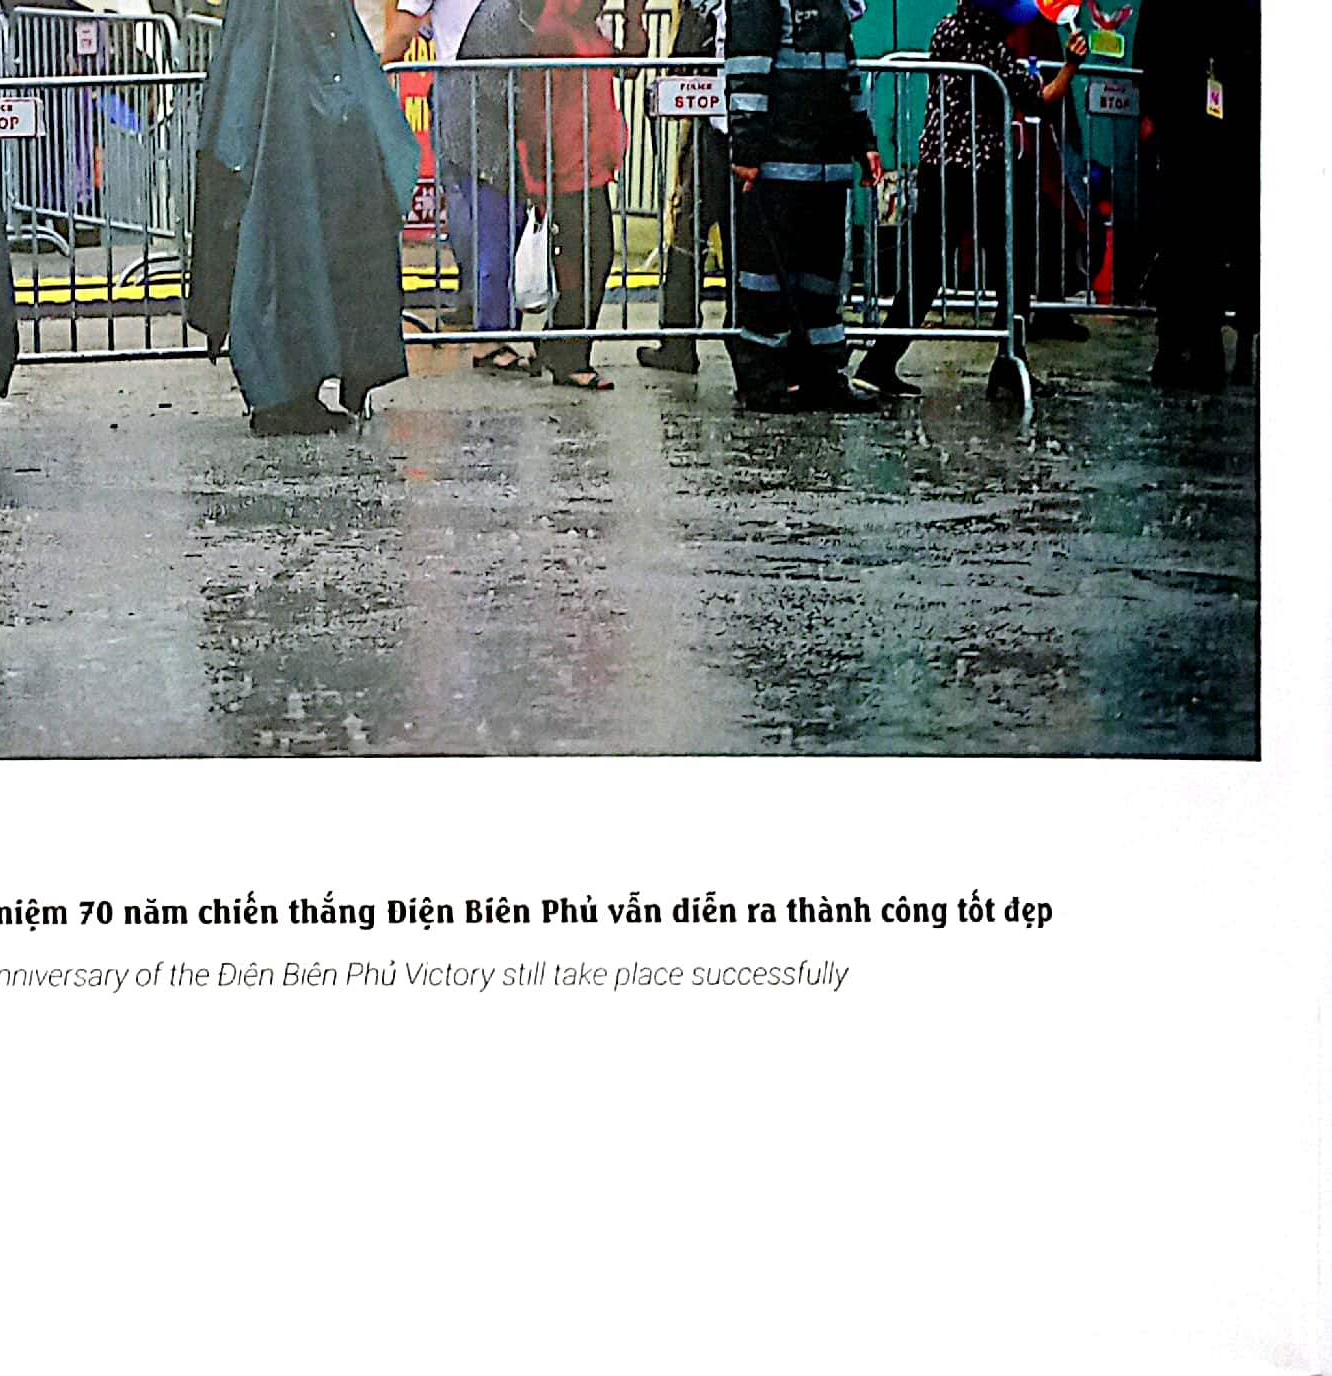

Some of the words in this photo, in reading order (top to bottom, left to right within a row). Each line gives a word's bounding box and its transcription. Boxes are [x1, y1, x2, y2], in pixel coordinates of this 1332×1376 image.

[675, 95, 720, 109] STOP
[78, 900, 114, 926] 70
[124, 897, 189, 925] năm
[198, 890, 279, 925] chiến
[288, 890, 375, 931] thắng
[387, 896, 455, 931] Điện
[465, 896, 531, 924] Biên
[541, 894, 599, 924] Phủ
[607, 890, 662, 925] vẫn
[672, 890, 738, 924] diễn
[747, 902, 777, 923] ra
[786, 895, 872, 923] thành
[881, 895, 948, 929] công
[956, 888, 996, 923] tốt
[1004, 896, 1053, 929] đẹp
[135, 960, 165, 988] of
[169, 961, 210, 988] the
[281, 960, 338, 988] Biên
[345, 959, 397, 987] Phủ
[405, 961, 496, 993] Victory
[502, 960, 547, 987] still
[553, 961, 608, 987] take
[613, 960, 684, 993] place
[691, 959, 850, 993] successfully
